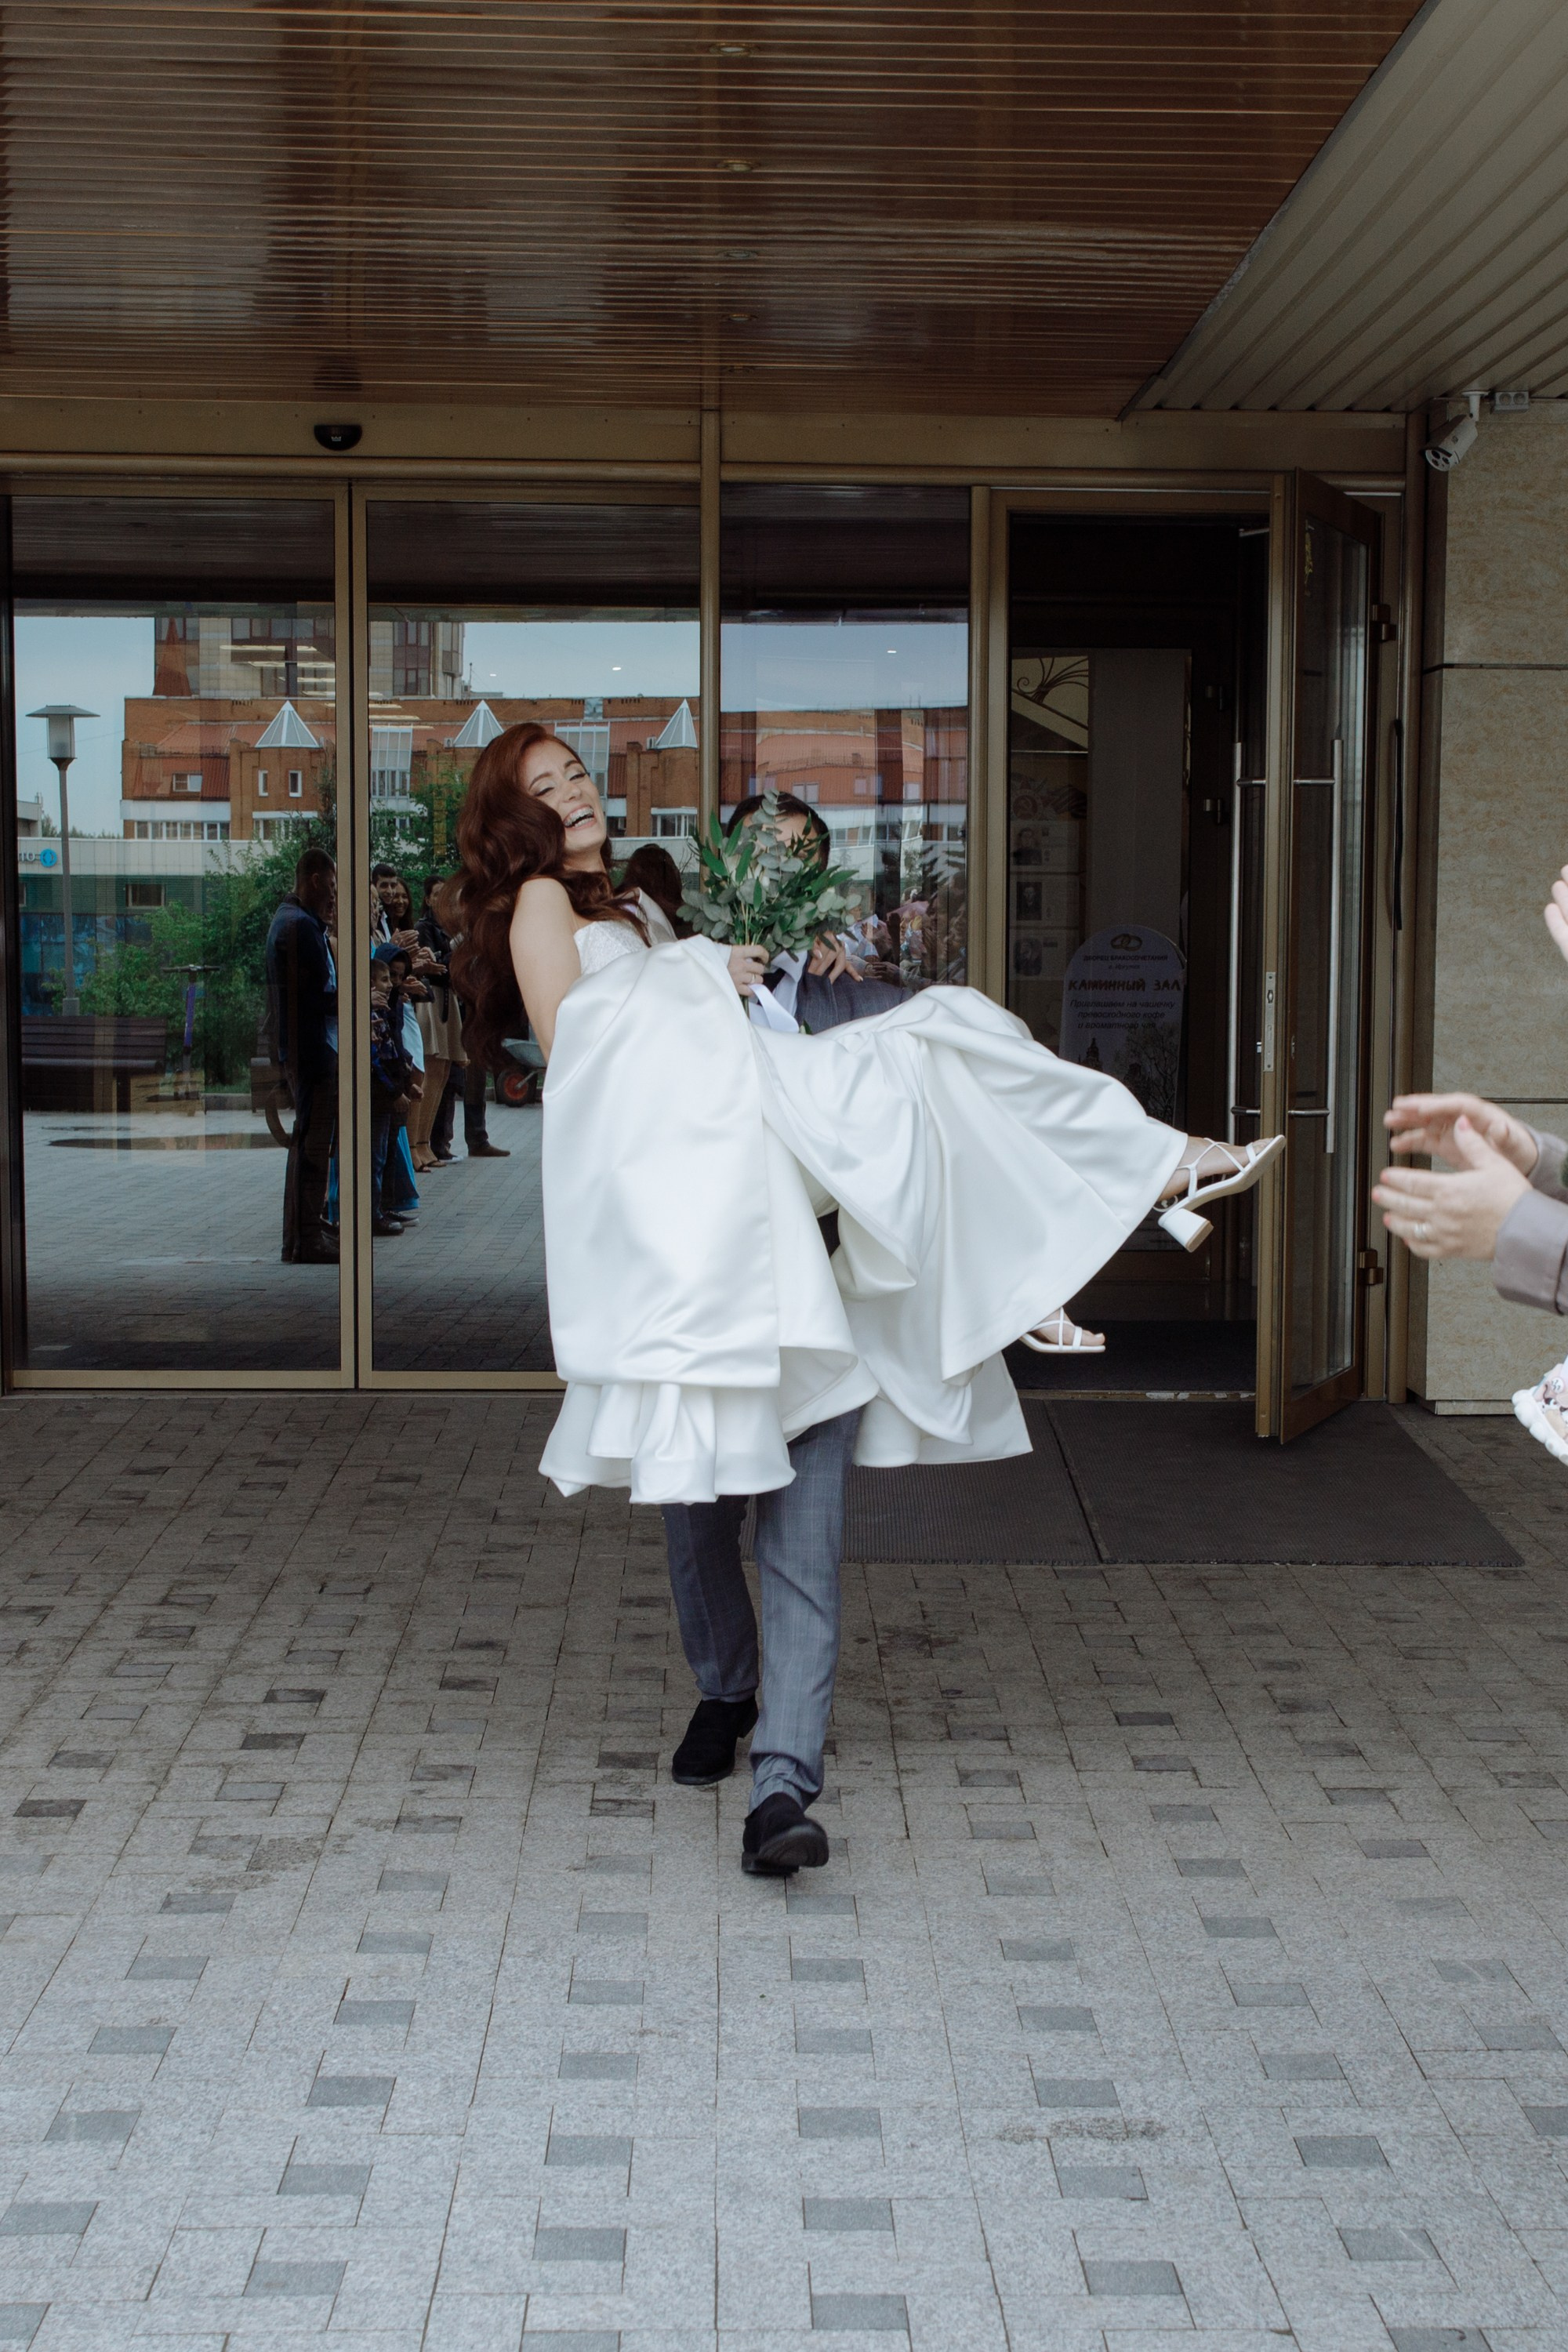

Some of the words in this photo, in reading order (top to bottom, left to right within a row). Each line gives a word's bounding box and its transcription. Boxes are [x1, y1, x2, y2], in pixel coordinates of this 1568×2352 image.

[1068, 978, 1146, 992] КАМИННЫЙ
[1153, 978, 1181, 991] ЗАЛ
[1069, 1000, 1125, 1008] Приглашаем
[1077, 1011, 1142, 1019] превосходного
